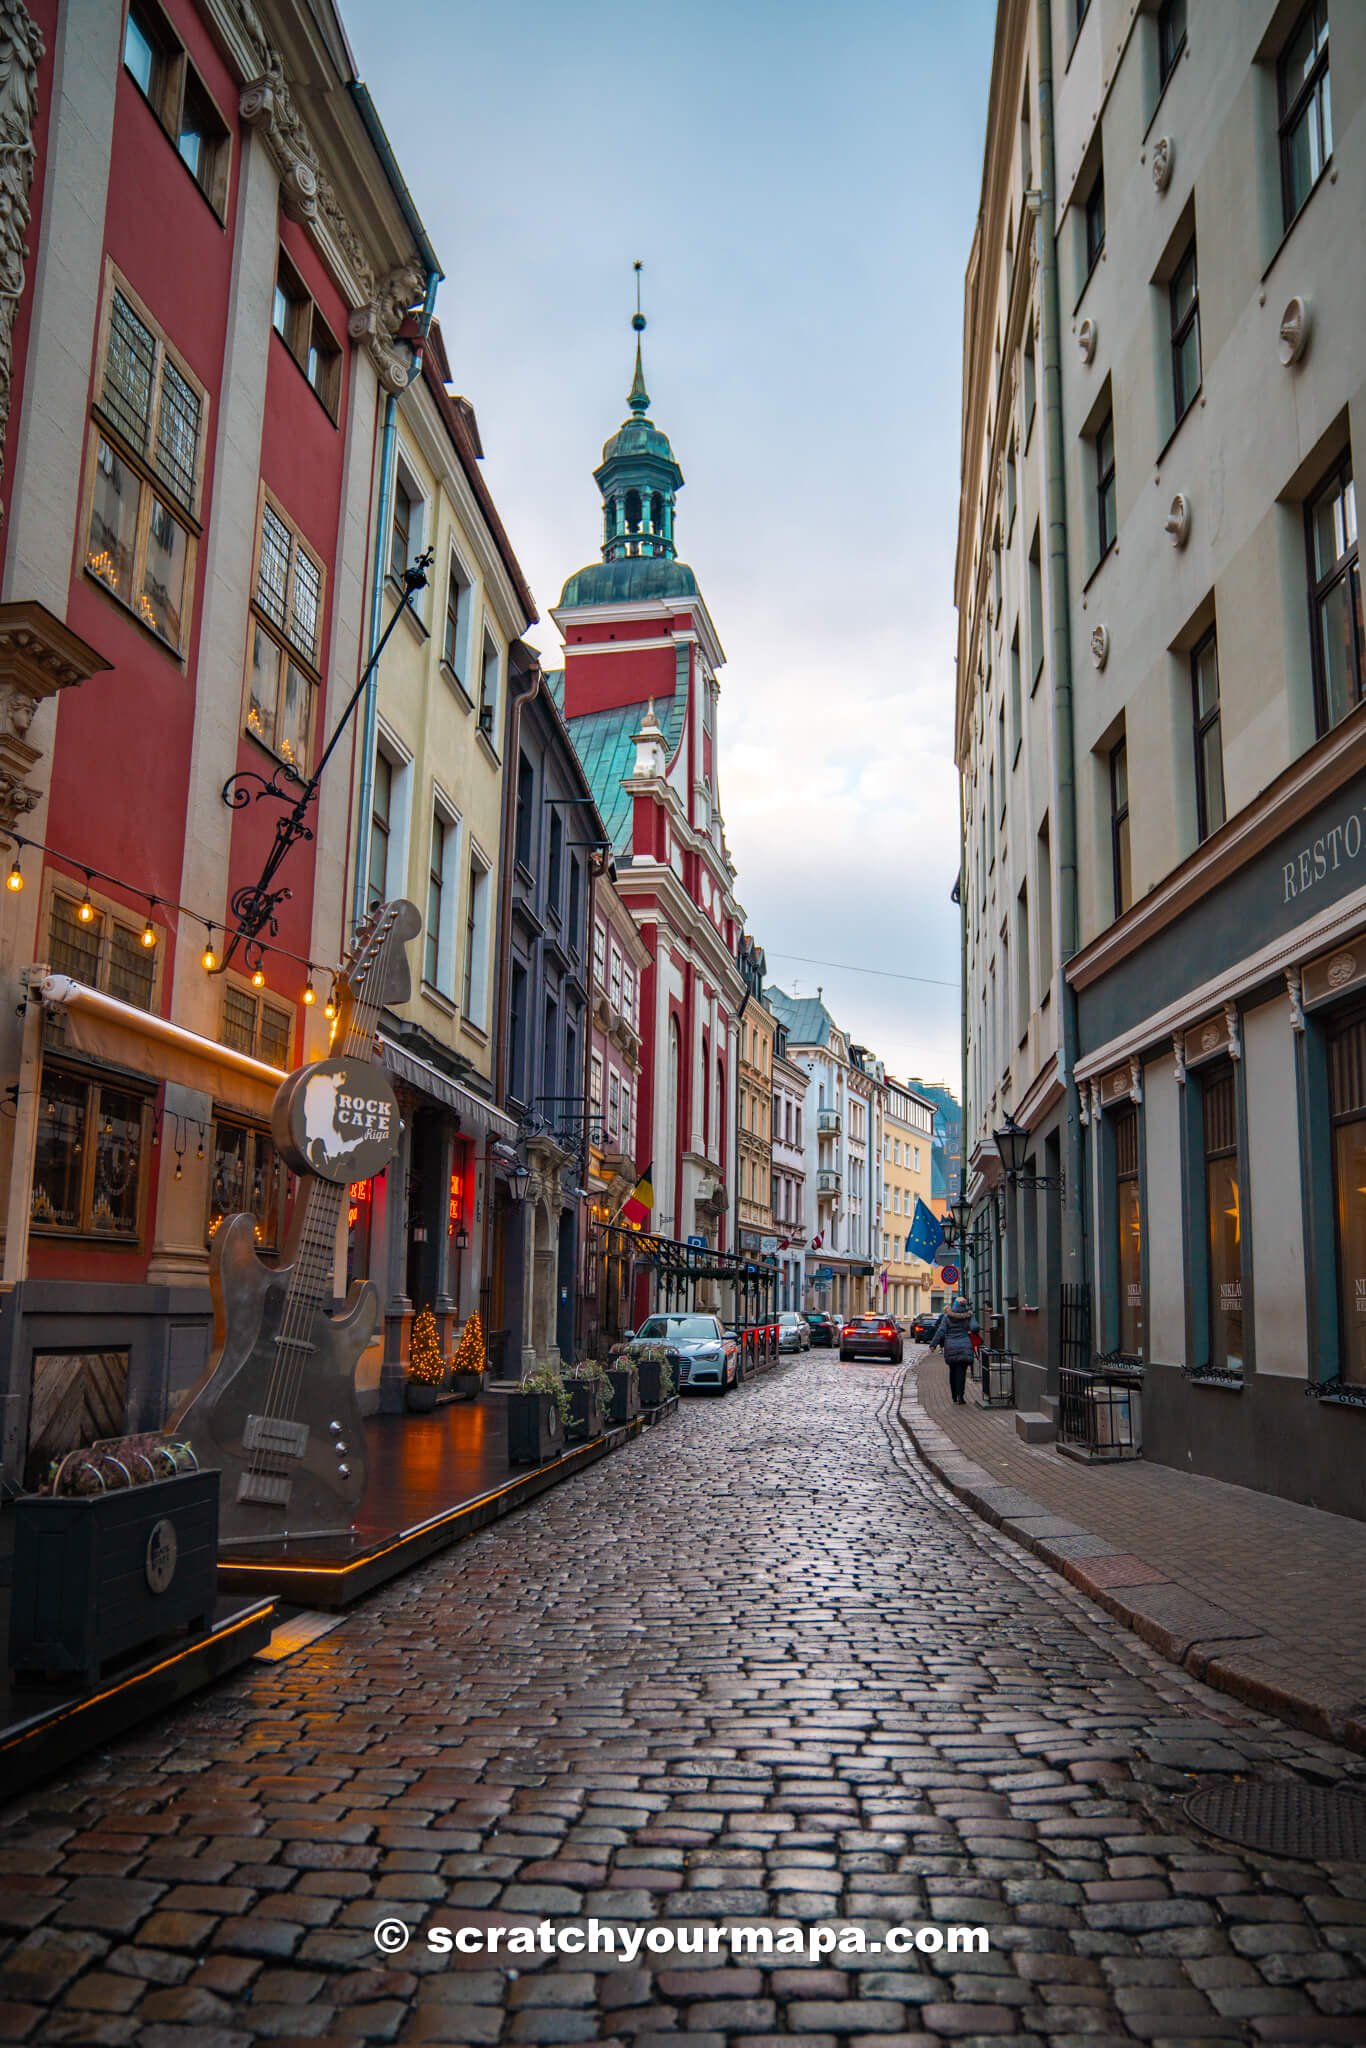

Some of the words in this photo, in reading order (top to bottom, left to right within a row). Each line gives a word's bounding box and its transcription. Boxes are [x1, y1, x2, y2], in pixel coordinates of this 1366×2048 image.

[338, 1093, 392, 1116] ROCK
[337, 1109, 390, 1130] CAFE
[363, 1127, 389, 1143] Riga
